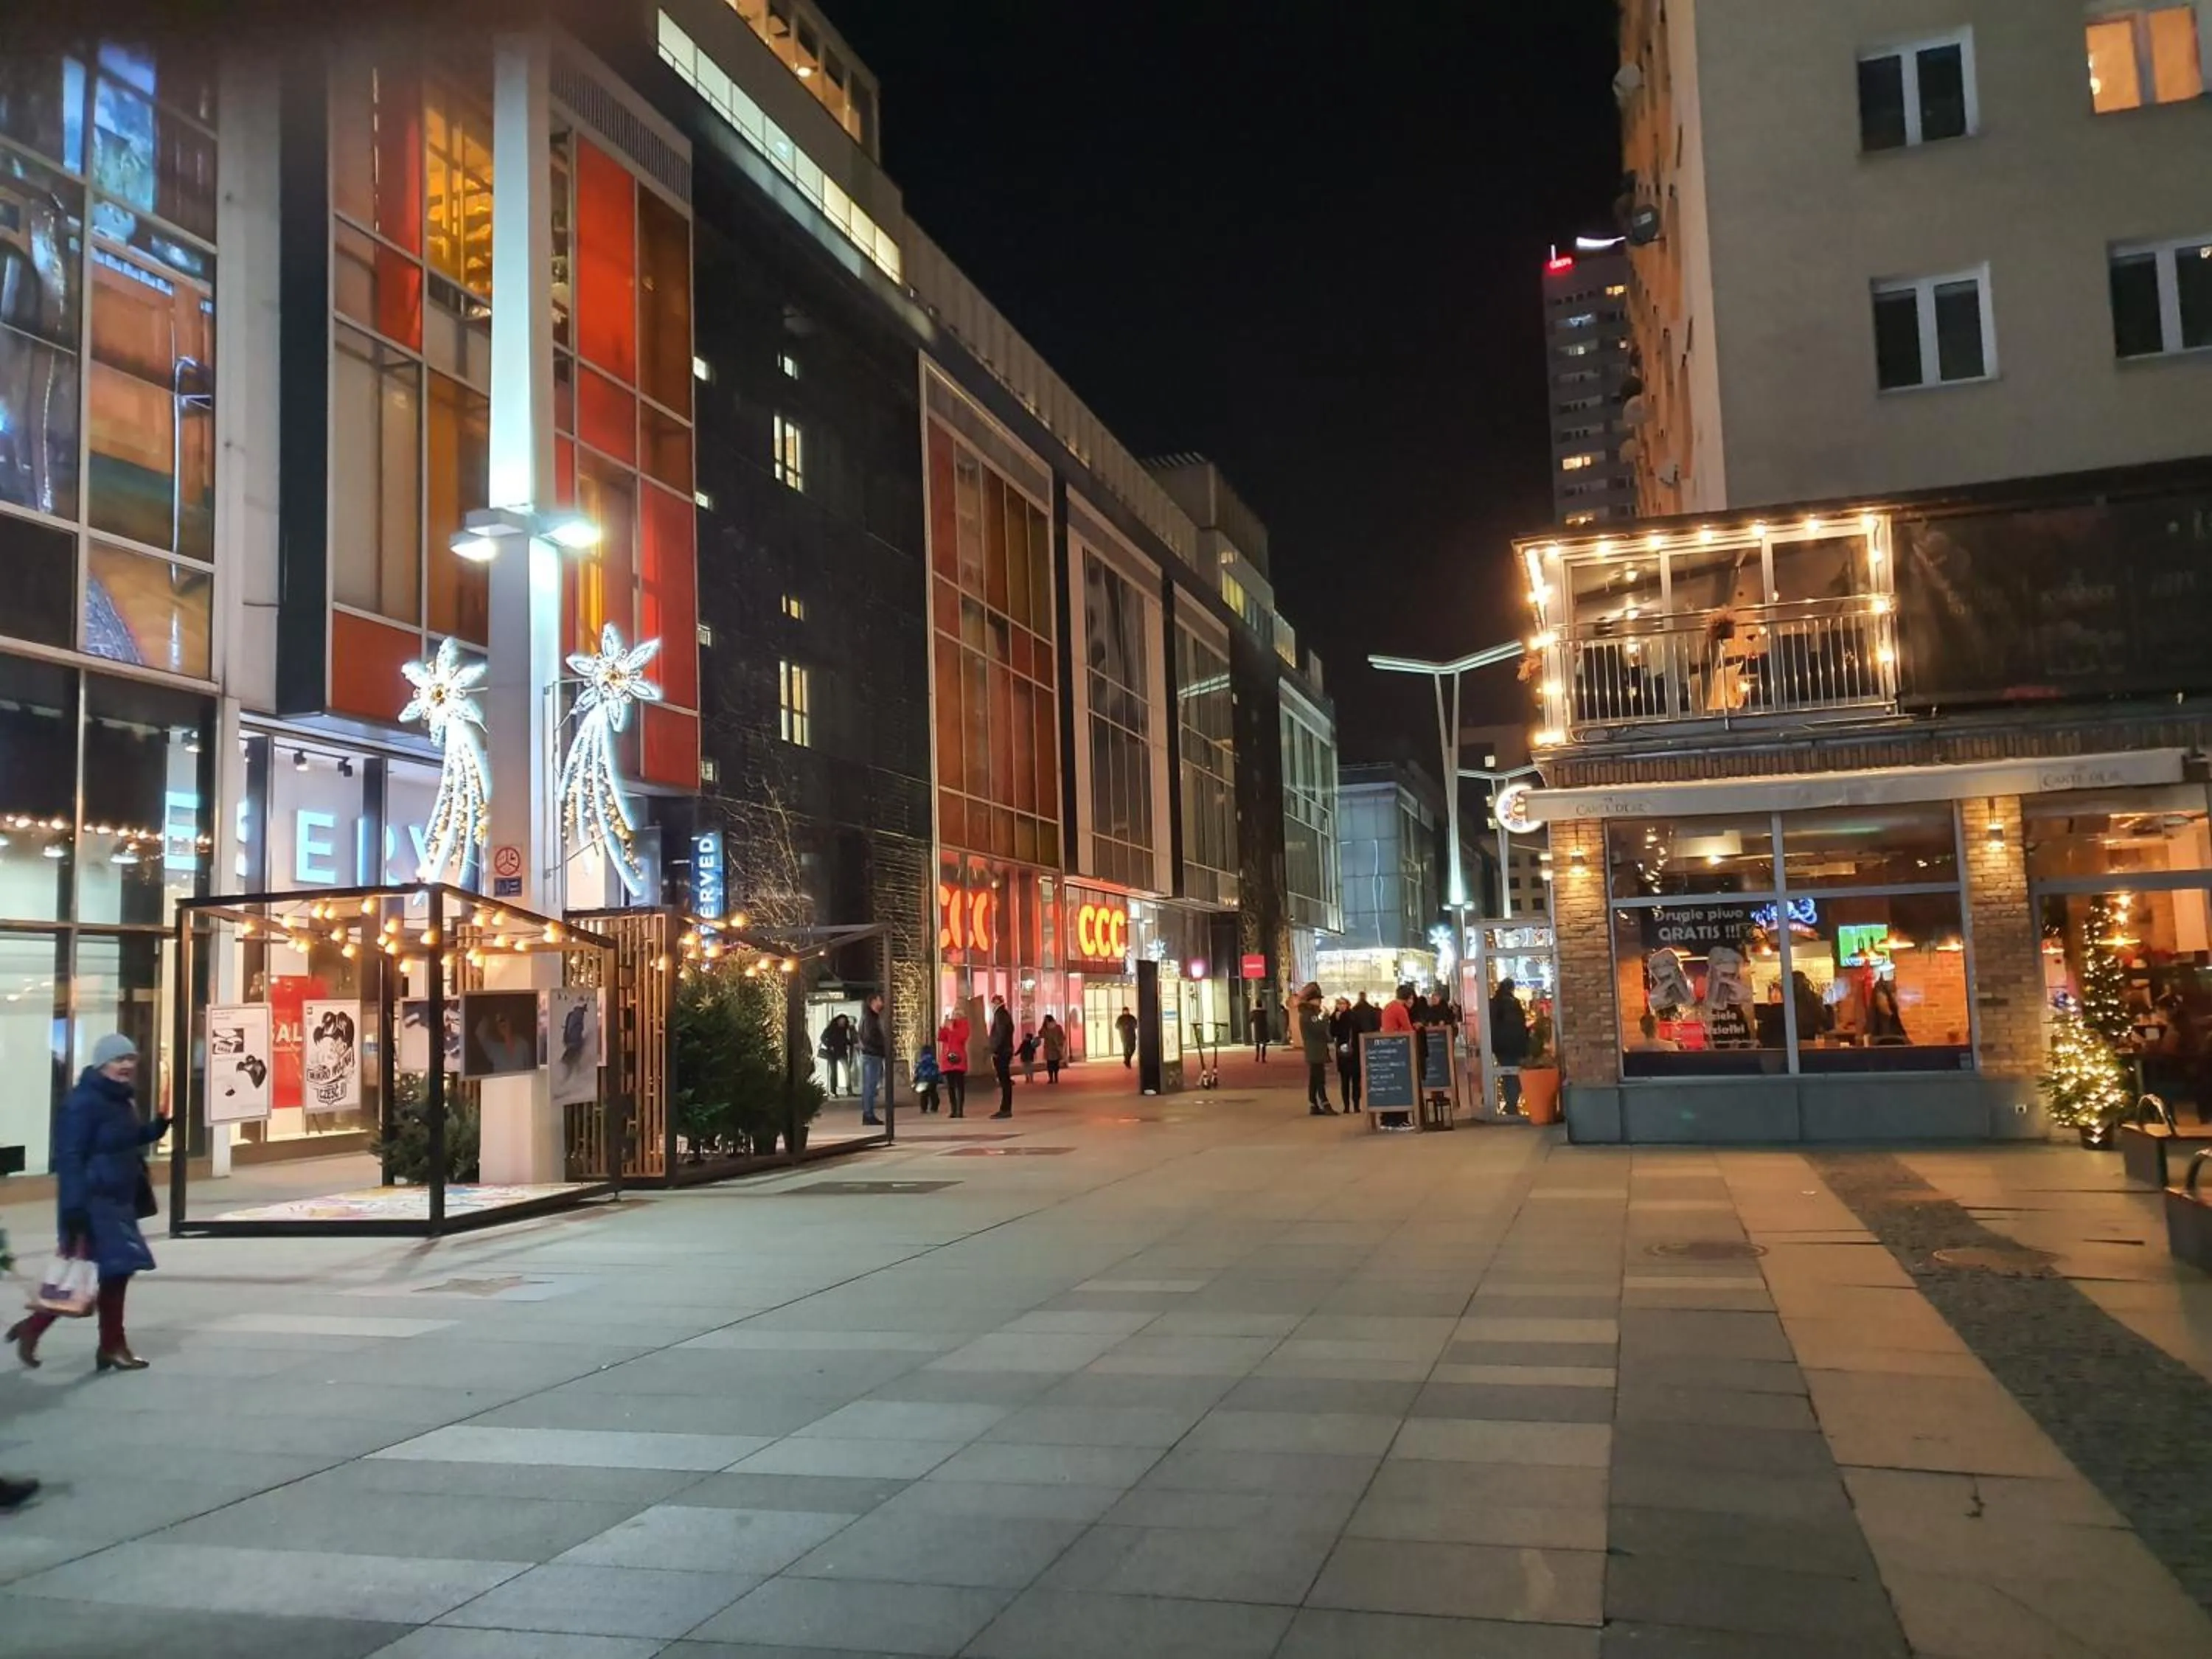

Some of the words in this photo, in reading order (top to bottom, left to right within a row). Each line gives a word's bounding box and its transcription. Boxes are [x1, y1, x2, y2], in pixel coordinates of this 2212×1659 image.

[1654, 908, 1703, 923] Drugie
[1708, 907, 1745, 922] piwo
[1079, 904, 1125, 958] CCC
[1658, 925, 1720, 941] GRATIS
